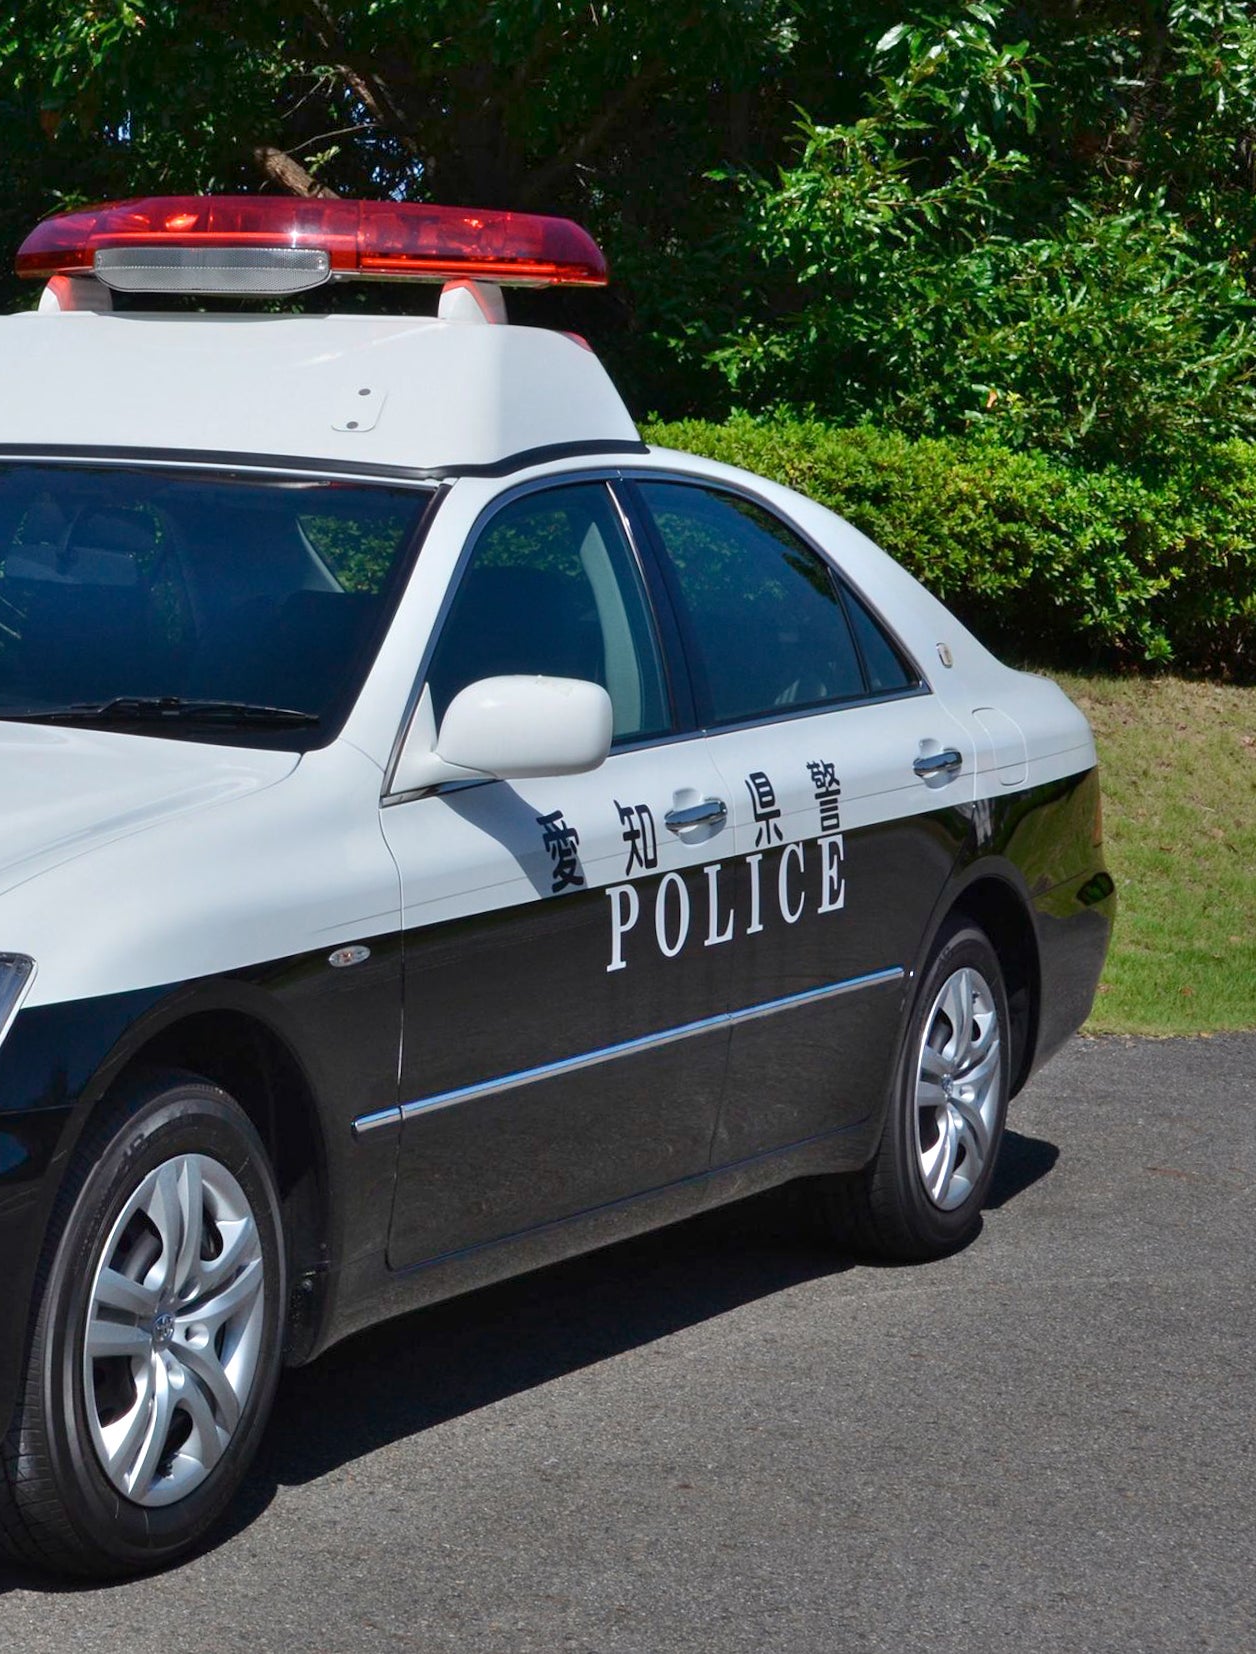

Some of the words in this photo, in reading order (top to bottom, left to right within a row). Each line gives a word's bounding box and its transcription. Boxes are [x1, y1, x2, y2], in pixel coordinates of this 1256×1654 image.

[536, 759, 841, 893] 愛知県警
[605, 834, 846, 973] POLICE
